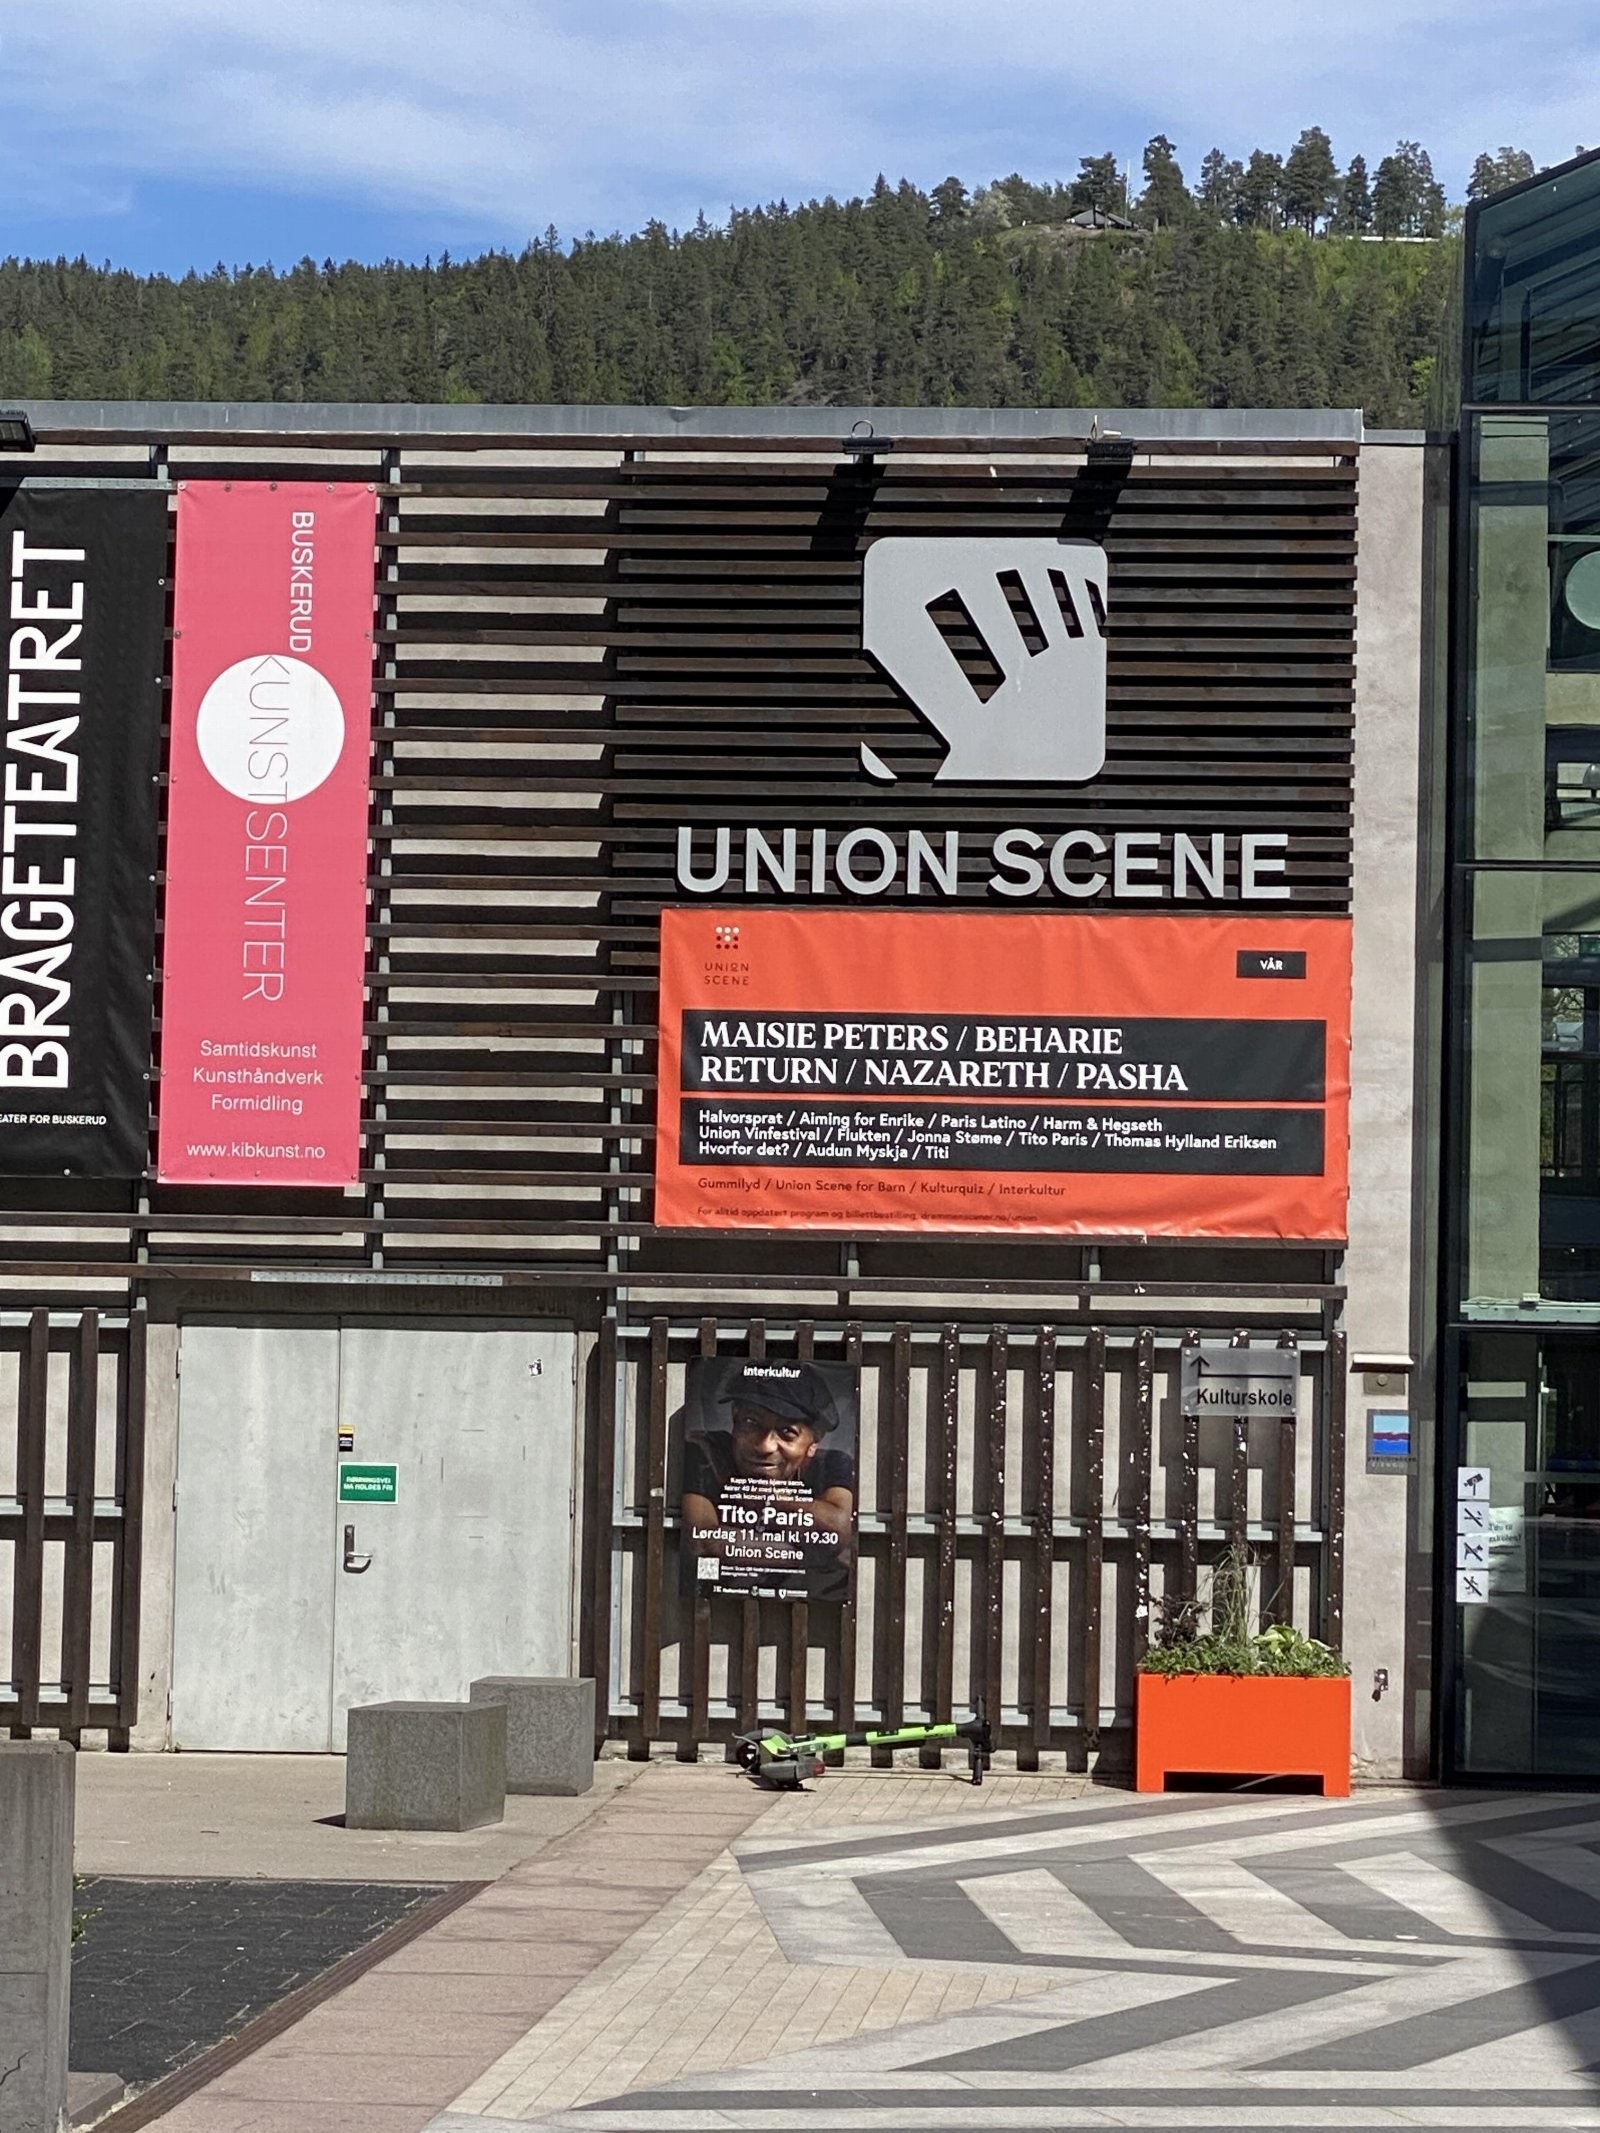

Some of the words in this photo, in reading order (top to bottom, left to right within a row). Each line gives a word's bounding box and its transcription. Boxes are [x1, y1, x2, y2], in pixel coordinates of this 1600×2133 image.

[289, 512, 314, 652] BUSKERUD
[0, 530, 85, 1088] BRAGETEATRET
[678, 827, 959, 895] UNION
[989, 829, 1291, 899] SCENE
[704, 962, 749, 973] UNION
[1260, 957, 1283, 970] VÅR
[704, 975, 749, 986] SCENE
[701, 1021, 816, 1049] MAISIE
[823, 1023, 949, 1051] PETERS
[975, 1026, 1123, 1055] BEHARIE
[200, 1040, 317, 1058] Samtidskunst
[193, 1067, 324, 1085] Kunsthåndverk
[701, 1056, 838, 1084] RETURN
[864, 1059, 1049, 1088] NAZARETH
[1076, 1063, 1189, 1091] PASHA
[211, 1093, 303, 1115] Formidling
[29, 1114, 51, 1124] FOR
[52, 1115, 107, 1125] BUSKERUD
[699, 1110, 783, 1126] Halvorsprat
[800, 1112, 850, 1129] Aiming
[854, 1113, 876, 1126] for
[880, 1113, 925, 1127] Enrike
[941, 1114, 977, 1128] Paris
[981, 1115, 1027, 1129] Latino
[1043, 1117, 1082, 1130] Harm
[1102, 1117, 1163, 1135] Hegseth
[699, 1126, 740, 1139] Union
[745, 1127, 820, 1141] Vinfestival
[837, 1128, 891, 1142] Flukten
[907, 1130, 950, 1142] Jonna
[955, 1131, 1002, 1144] Støme
[1018, 1132, 1048, 1145] Tito
[1052, 1133, 1088, 1146] Paris
[1105, 1133, 1161, 1147] Thomas
[1165, 1134, 1220, 1151] Hylland
[1224, 1135, 1277, 1149] Eriksen
[186, 1142, 326, 1159] www.kibkunst.no
[699, 1141, 754, 1155] Hvorfor
[756, 1142, 790, 1156] det?
[806, 1144, 852, 1157] Audun
[856, 1144, 908, 1161] Myskja
[925, 1146, 949, 1159] Titi
[698, 1178, 760, 1192] Gummilyd
[776, 1180, 811, 1191] Union
[816, 1181, 852, 1192] Scene
[856, 1181, 873, 1192] for
[878, 1181, 905, 1192] Barn
[921, 1182, 984, 1196] Kulturquiz
[1000, 1183, 1066, 1196] Interkultur
[743, 1366, 801, 1378] interkultur
[1197, 1388, 1292, 1406] Kulturskole
[718, 1505, 758, 1523] Tito
[763, 1507, 814, 1527] Paris
[692, 1526, 736, 1543] Lørdag
[741, 1528, 759, 1541] 11.
[762, 1530, 785, 1543] mai
[789, 1530, 800, 1543] kl
[804, 1532, 839, 1544] 19.30
[725, 1545, 761, 1559] Union
[765, 1546, 804, 1559] Scene
